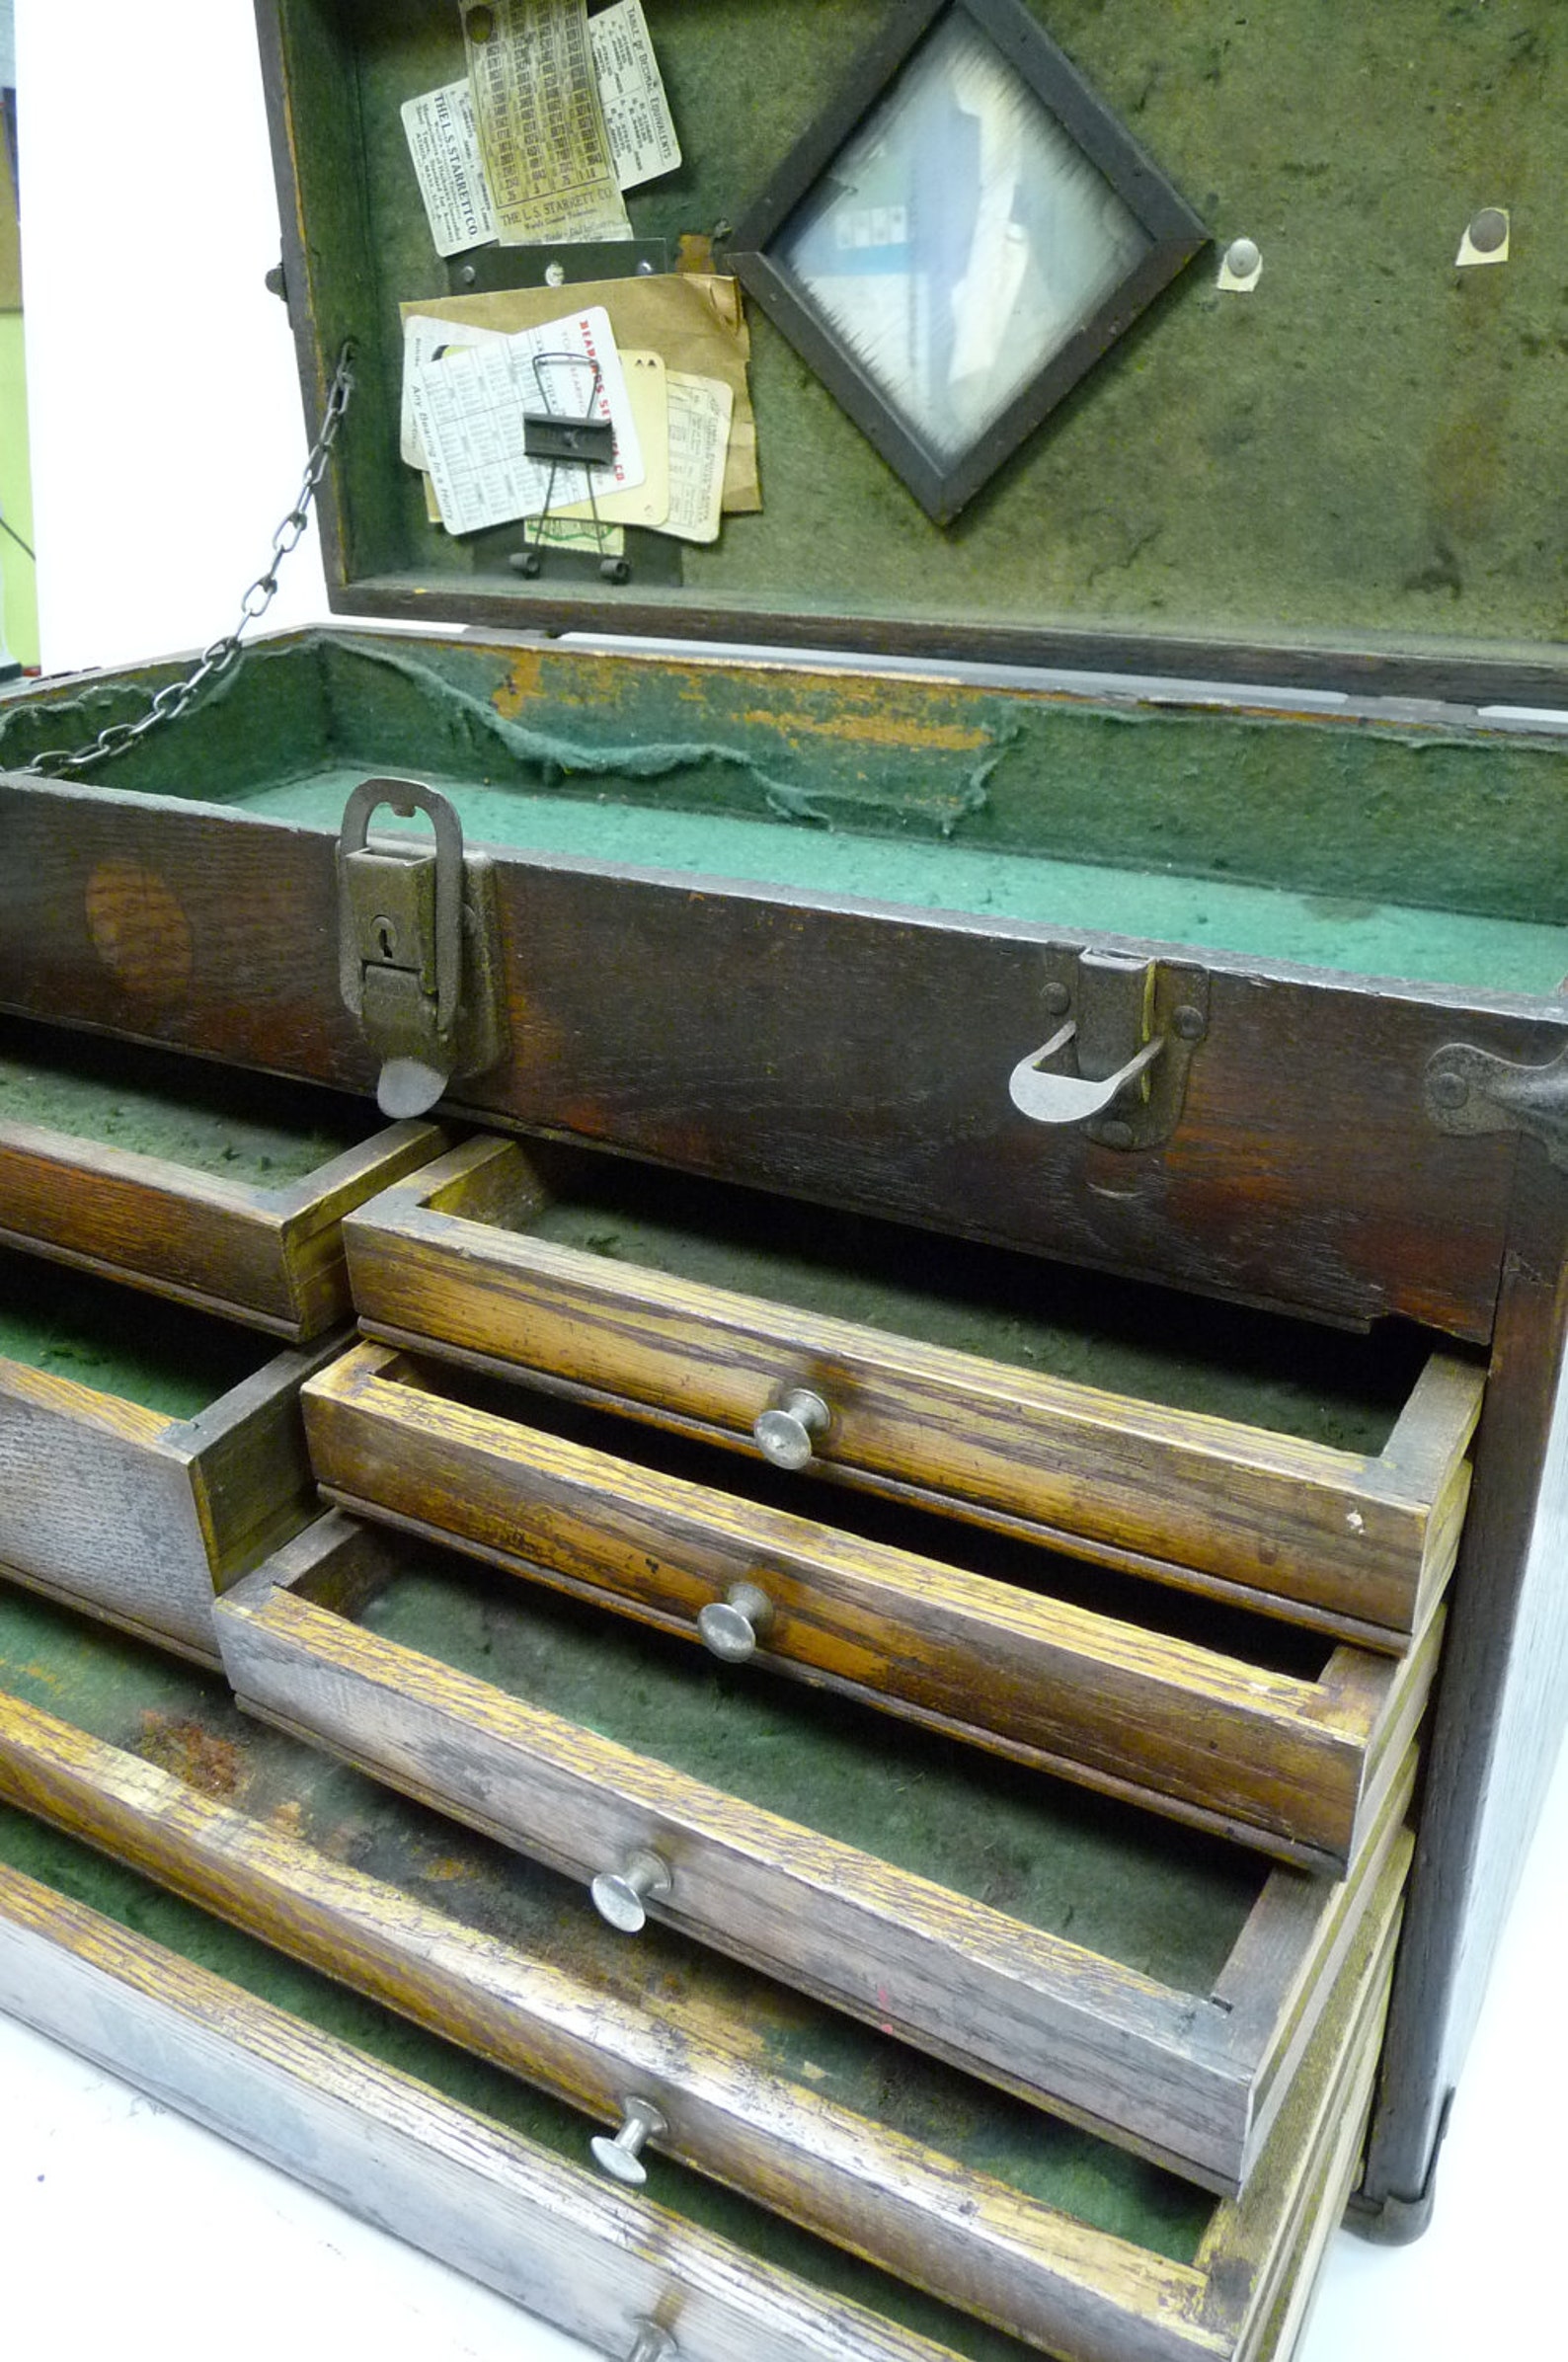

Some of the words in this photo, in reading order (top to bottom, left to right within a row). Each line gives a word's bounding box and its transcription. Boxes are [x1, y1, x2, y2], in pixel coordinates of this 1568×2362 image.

[433, 94, 449, 122] THE
[446, 145, 473, 216] STARRETT
[647, 96, 674, 159] EQUIVALENTS
[500, 210, 521, 226] THE
[541, 191, 594, 215] STARRETT
